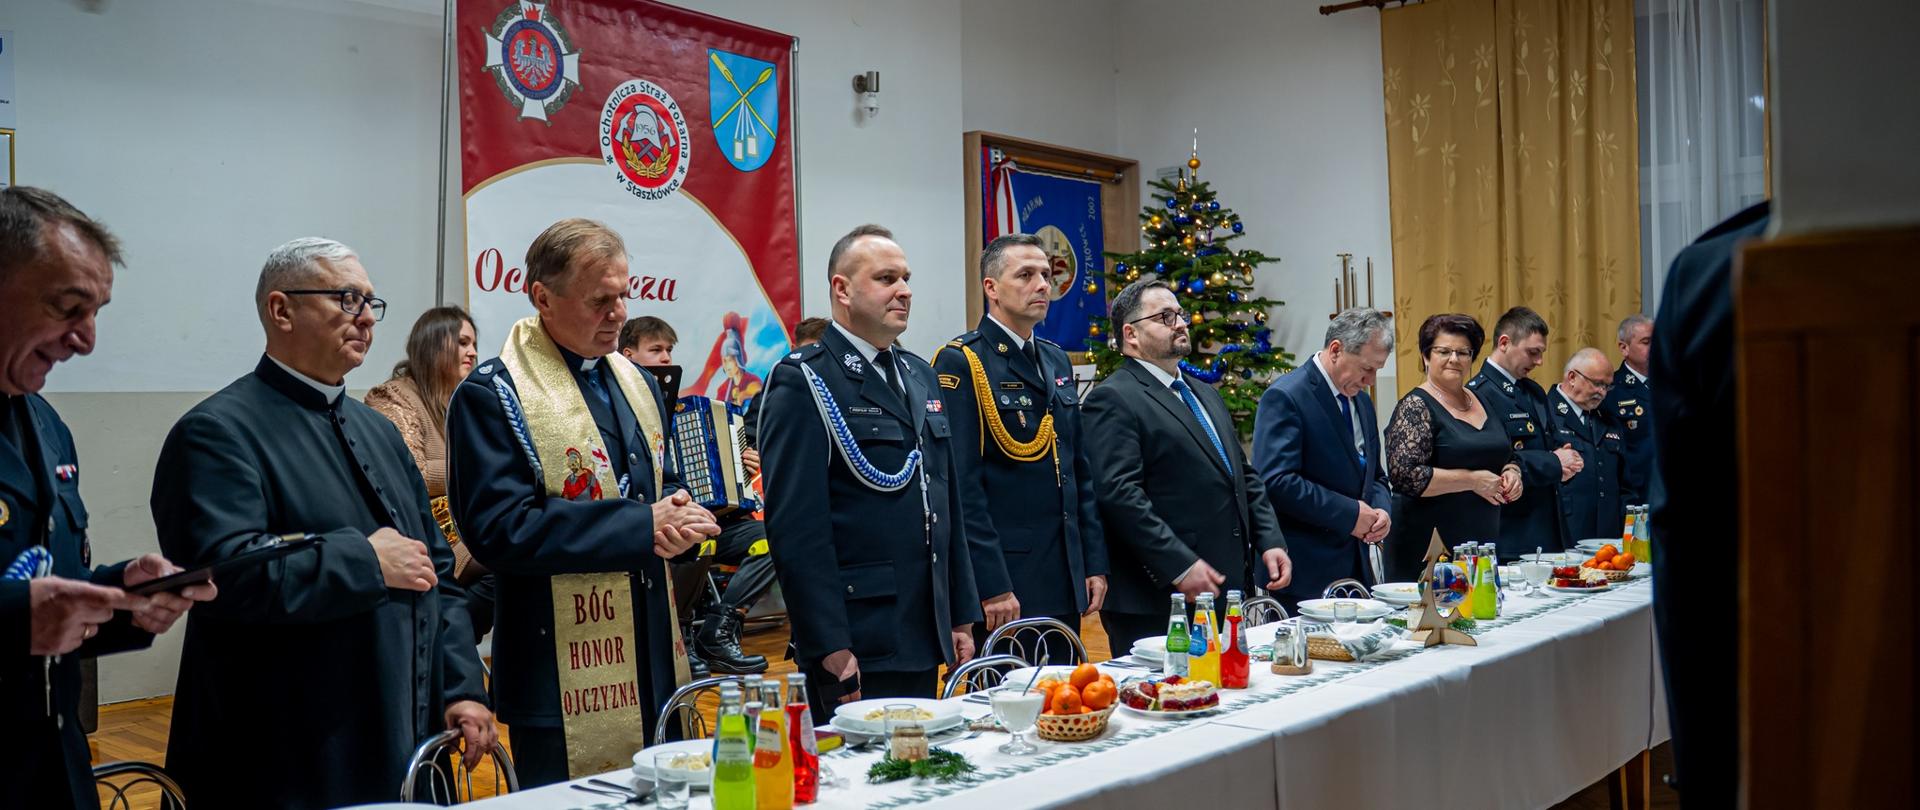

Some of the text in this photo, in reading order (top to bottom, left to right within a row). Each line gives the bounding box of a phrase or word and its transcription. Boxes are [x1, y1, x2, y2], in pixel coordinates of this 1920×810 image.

[601, 81, 688, 159] Ochotnicza Straż Pożarna
[636, 123, 656, 135] 1956
[616, 171, 680, 201] w Staszkówce
[573, 585, 615, 625] BÓG
[569, 636, 625, 670] HONOR
[564, 681, 638, 716] OJCZYZNA
